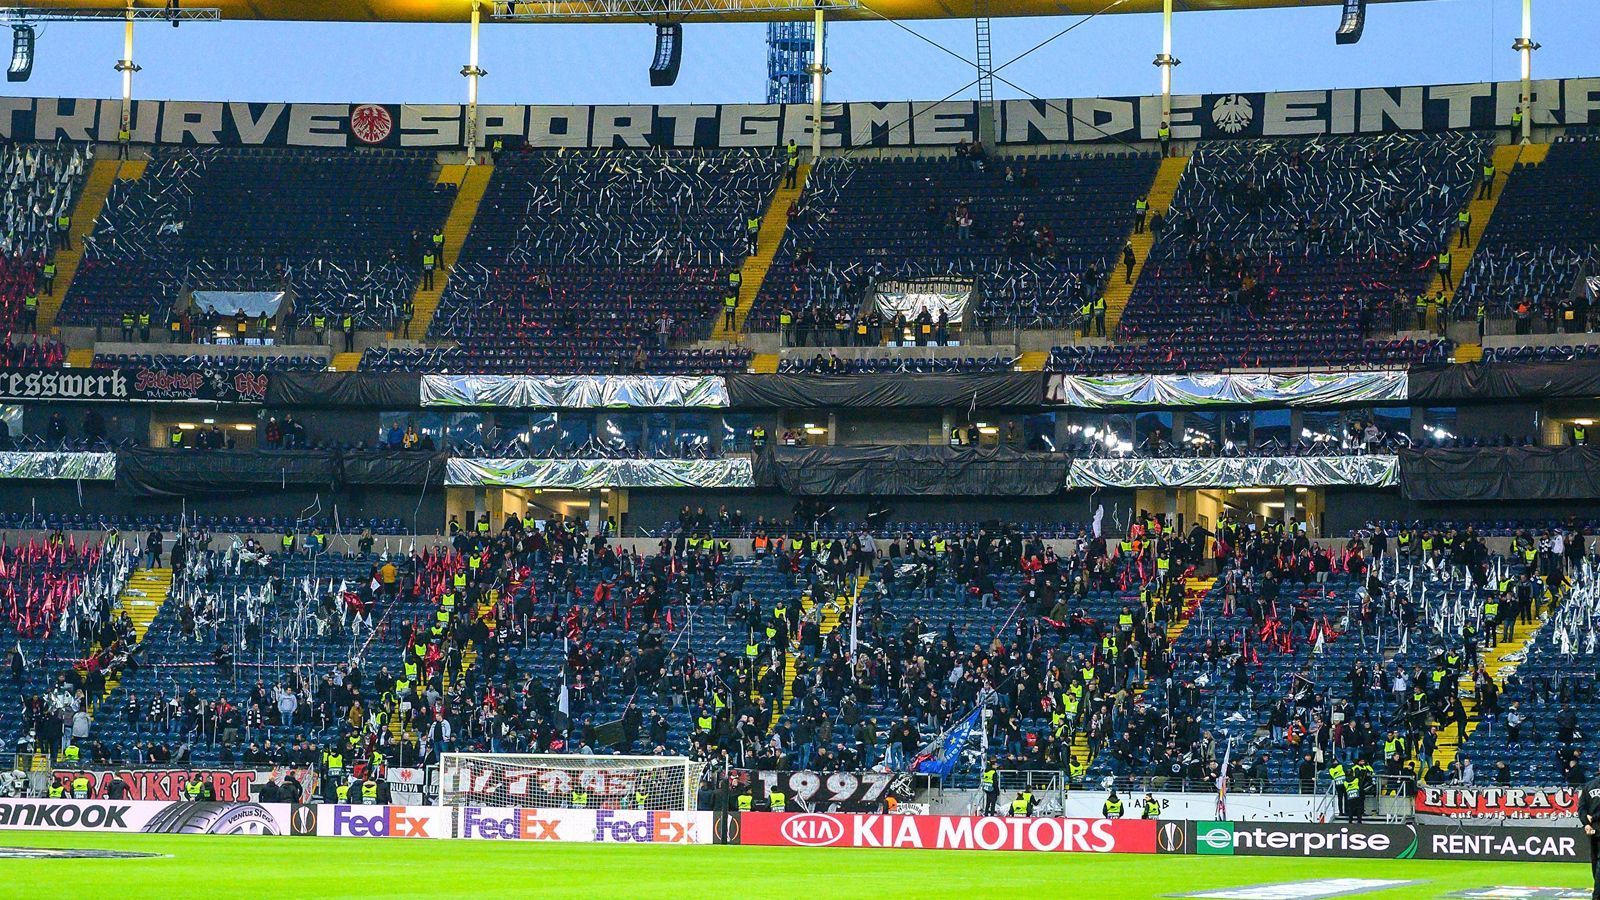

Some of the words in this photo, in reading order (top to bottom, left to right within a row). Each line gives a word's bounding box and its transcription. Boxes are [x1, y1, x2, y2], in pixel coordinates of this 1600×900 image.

[758, 772, 895, 801] 1997
[1424, 787, 1583, 808] EINTRAC
[333, 805, 429, 838] FedEx
[463, 807, 561, 840] FedEx
[596, 810, 695, 843] FedEx
[791, 820, 833, 839] KIA
[1450, 811, 1472, 819] auf
[1478, 811, 1505, 821] ewig
[1508, 810, 1530, 819] dir
[853, 816, 923, 848] KIA
[935, 817, 1115, 853] MOTORS
[1202, 827, 1390, 855] enterprise
[1433, 834, 1576, 857] RENT-A-CAR
